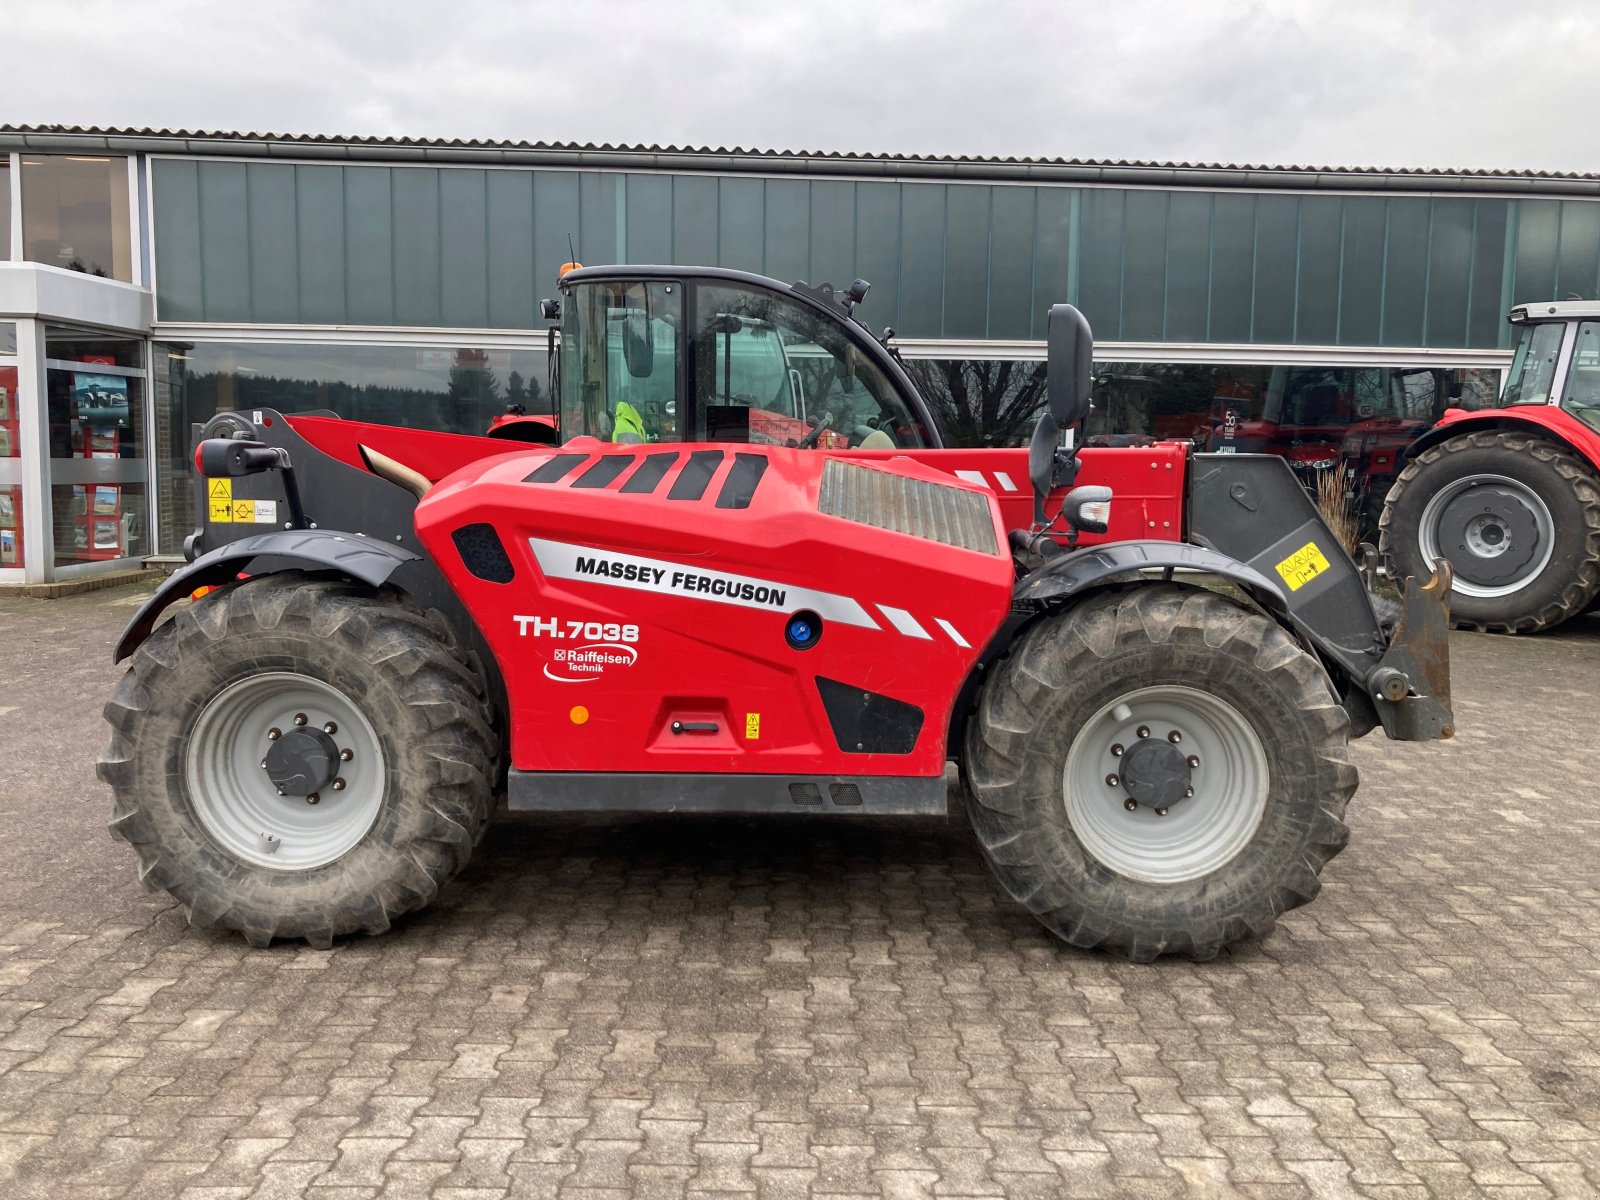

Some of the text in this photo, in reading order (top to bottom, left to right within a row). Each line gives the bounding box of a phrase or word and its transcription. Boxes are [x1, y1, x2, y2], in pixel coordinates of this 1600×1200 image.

[1225, 411, 1235, 426] 50
[575, 556, 786, 606] MASSEY FERGUSON
[513, 615, 639, 642] TH.7038
[568, 650, 631, 664] Raiffeisen
[567, 662, 603, 673] Technik
